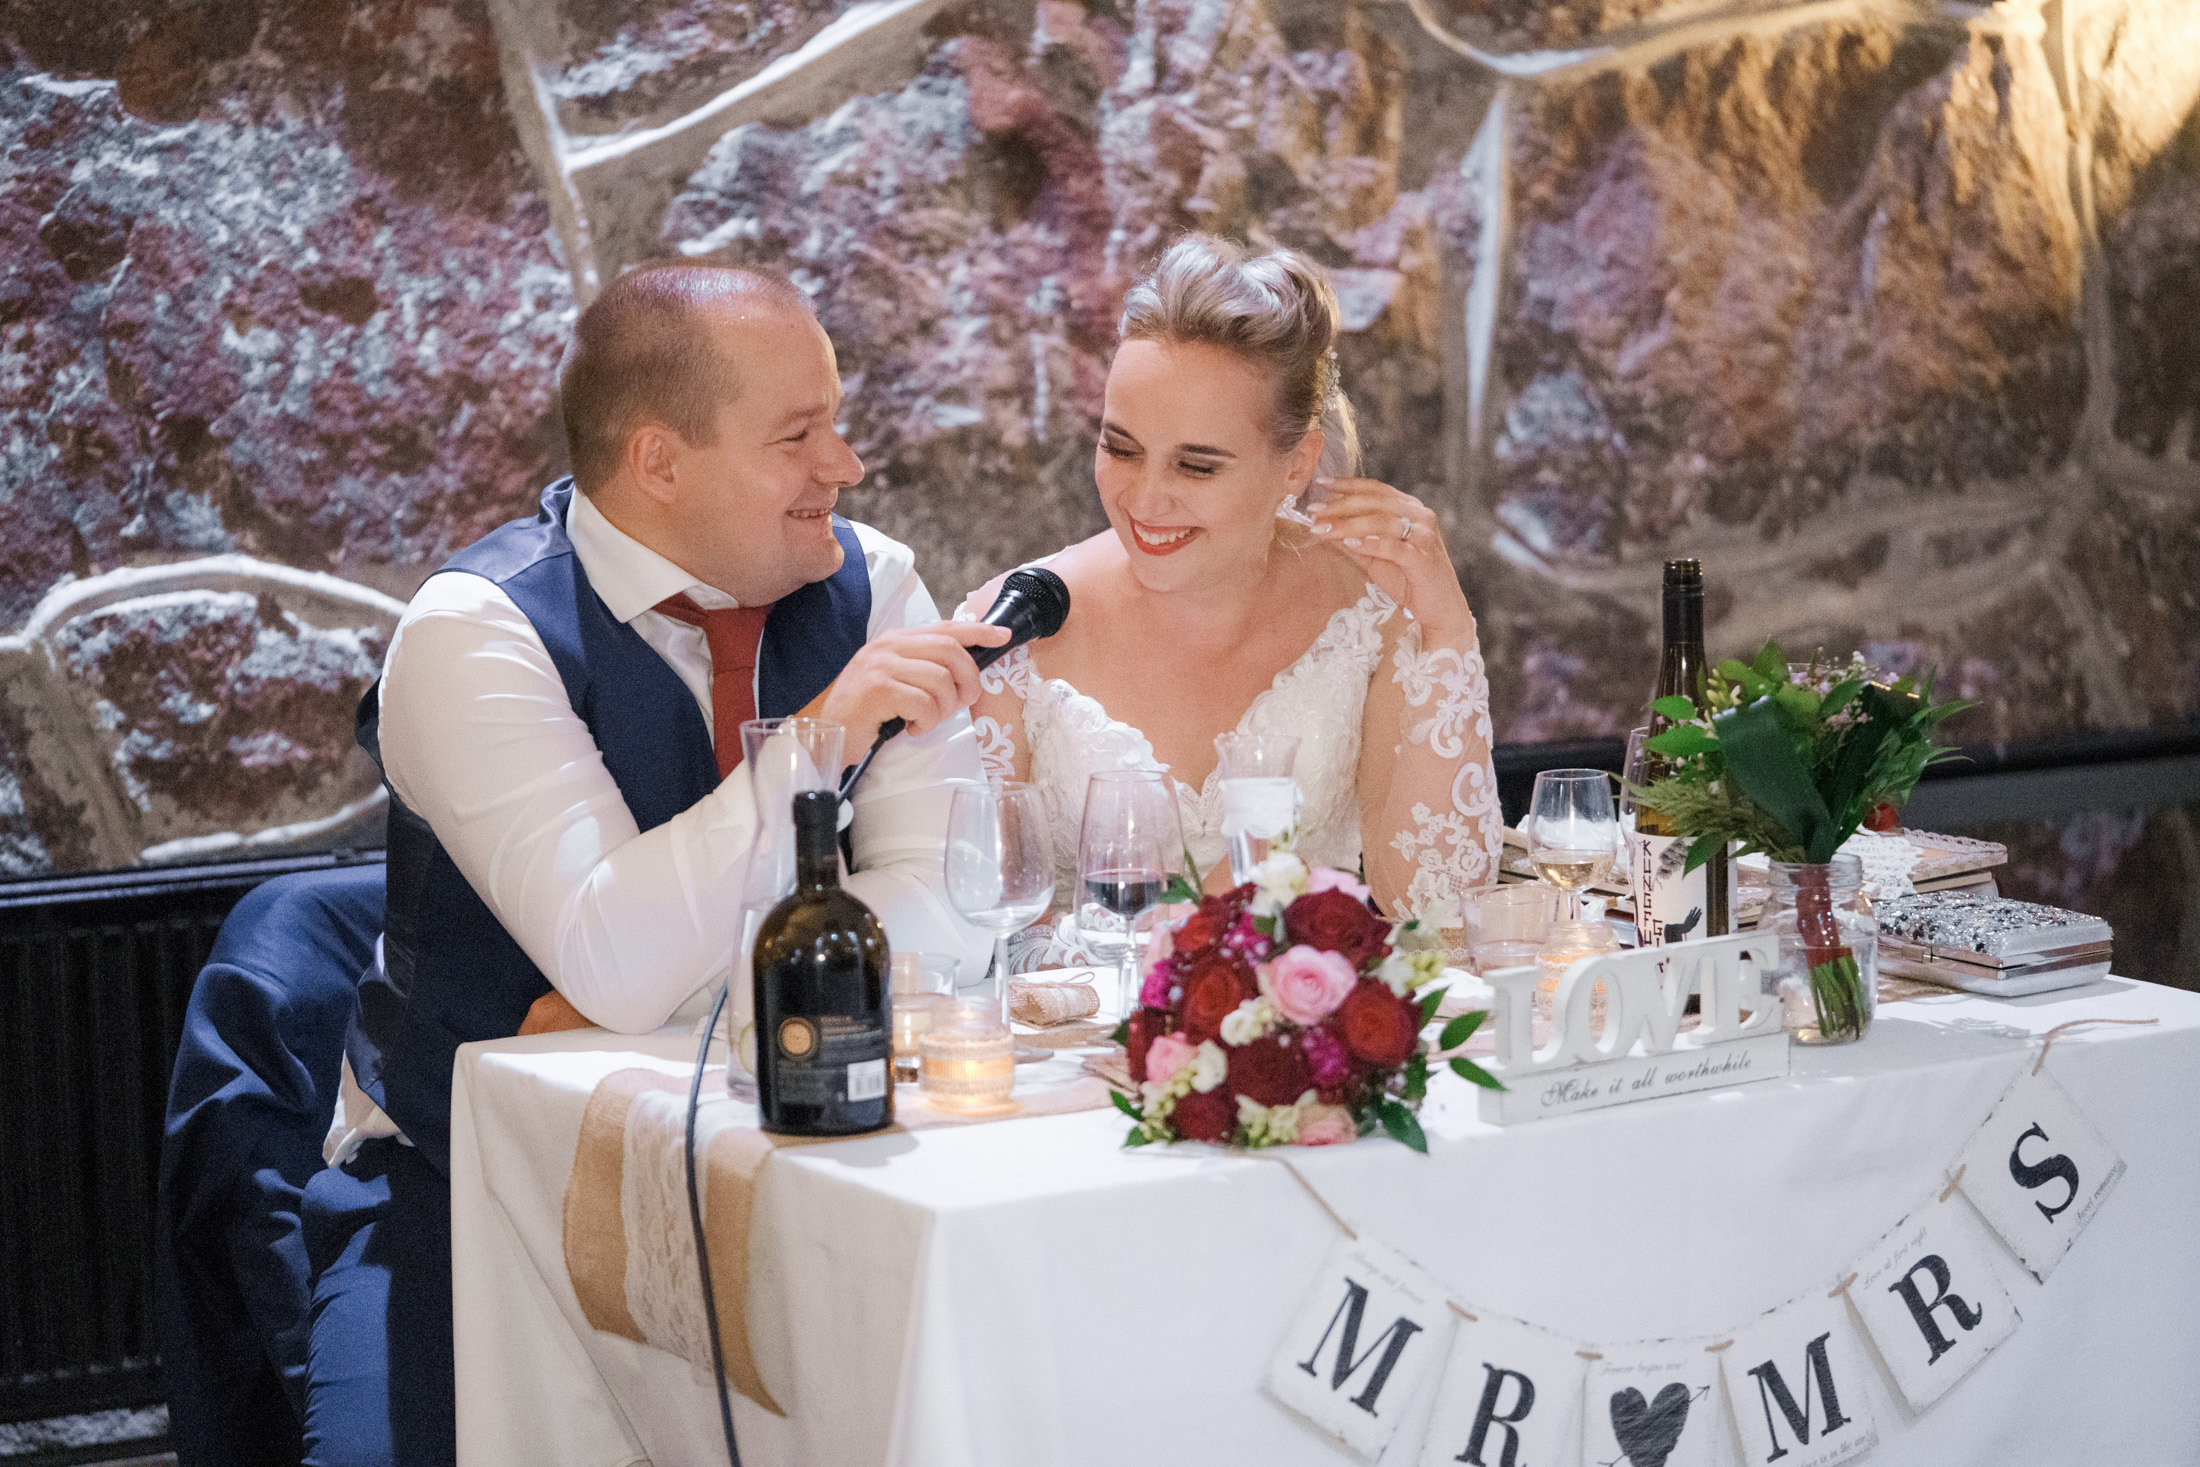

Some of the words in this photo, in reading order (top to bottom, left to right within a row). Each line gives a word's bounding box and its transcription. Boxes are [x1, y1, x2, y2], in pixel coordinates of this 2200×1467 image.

[1483, 933, 1783, 1077] LOVE
[1541, 1078, 1599, 1107] Make
[1608, 1077, 1622, 1092] it
[1632, 1066, 1658, 1090] all
[1665, 1050, 1752, 1084] worthwhile
